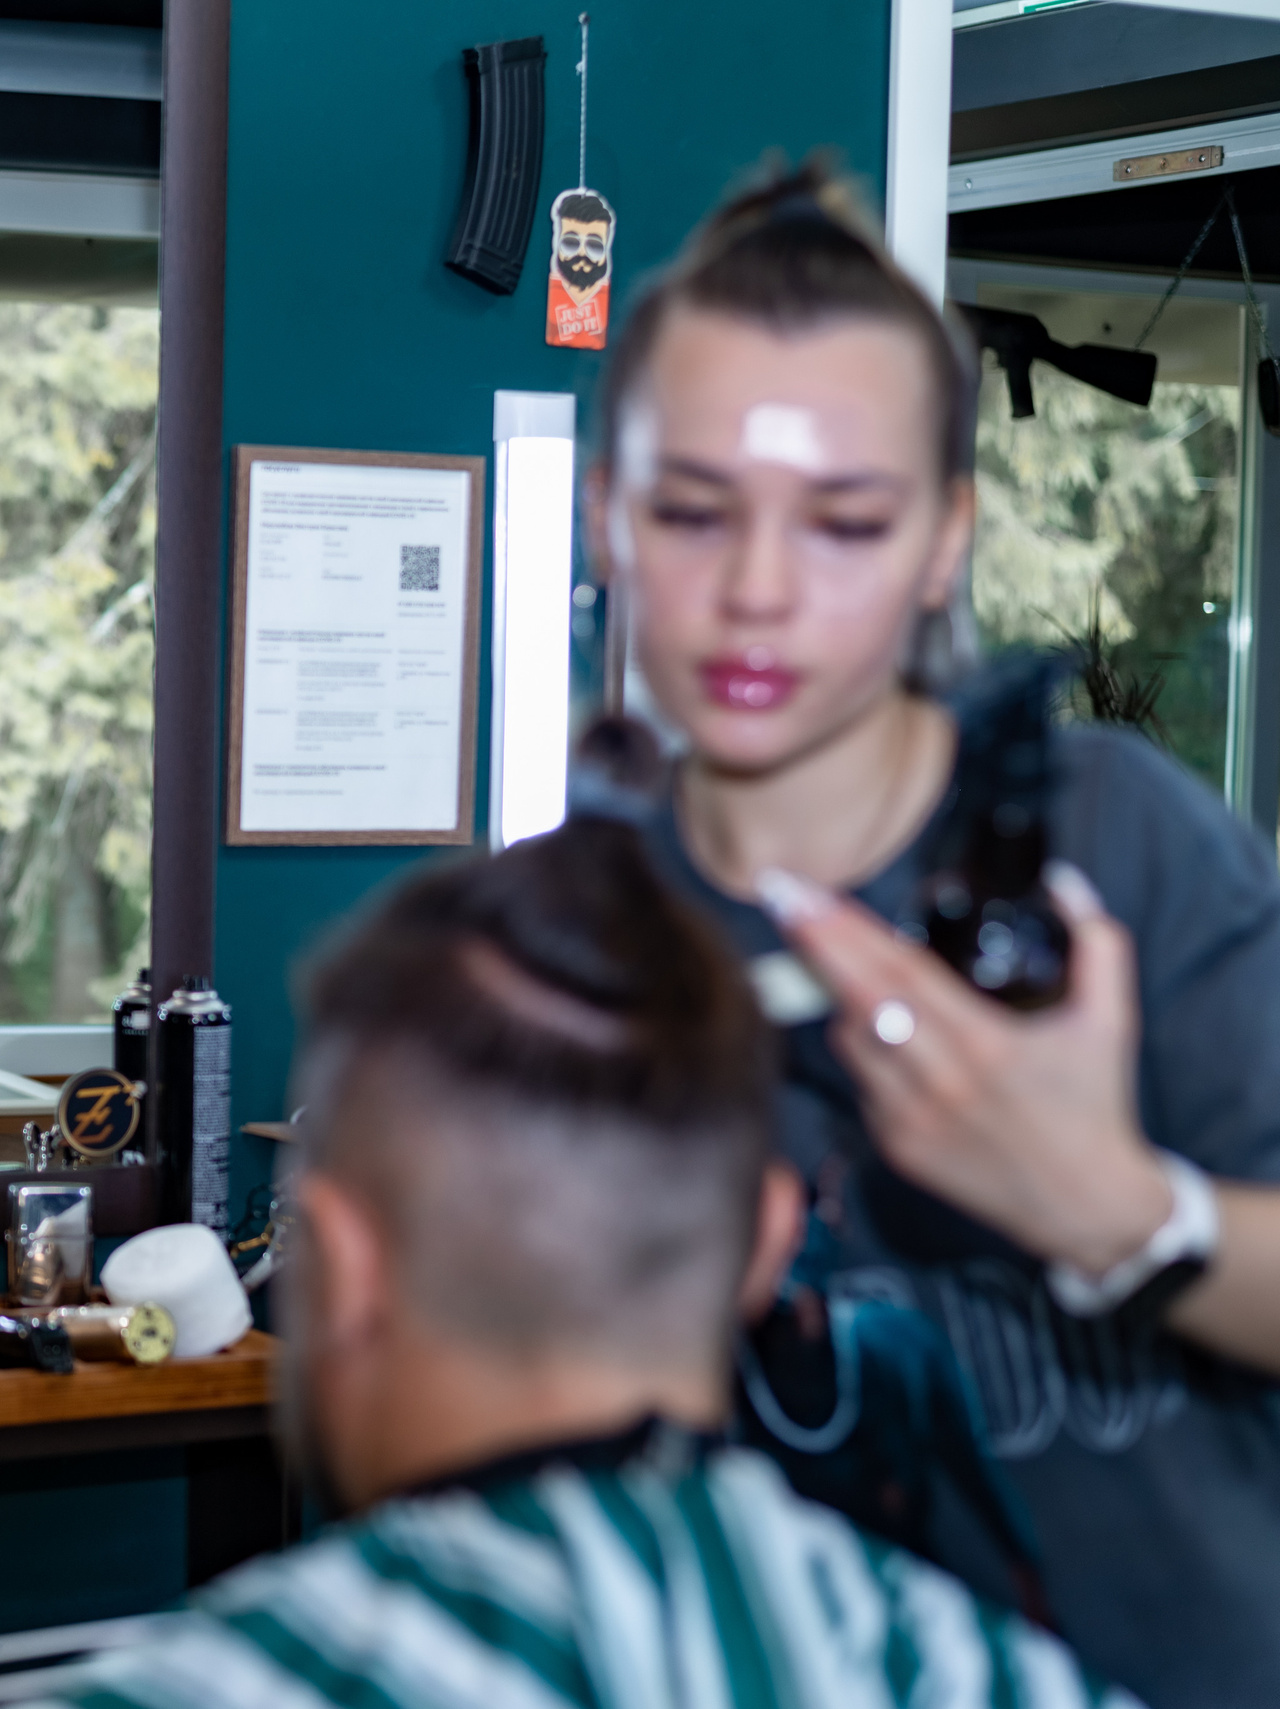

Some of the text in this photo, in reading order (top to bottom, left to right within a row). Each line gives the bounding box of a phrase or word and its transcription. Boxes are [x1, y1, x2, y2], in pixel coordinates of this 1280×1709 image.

[560, 304, 592, 323] JUST
[562, 316, 597, 336] DO IT
